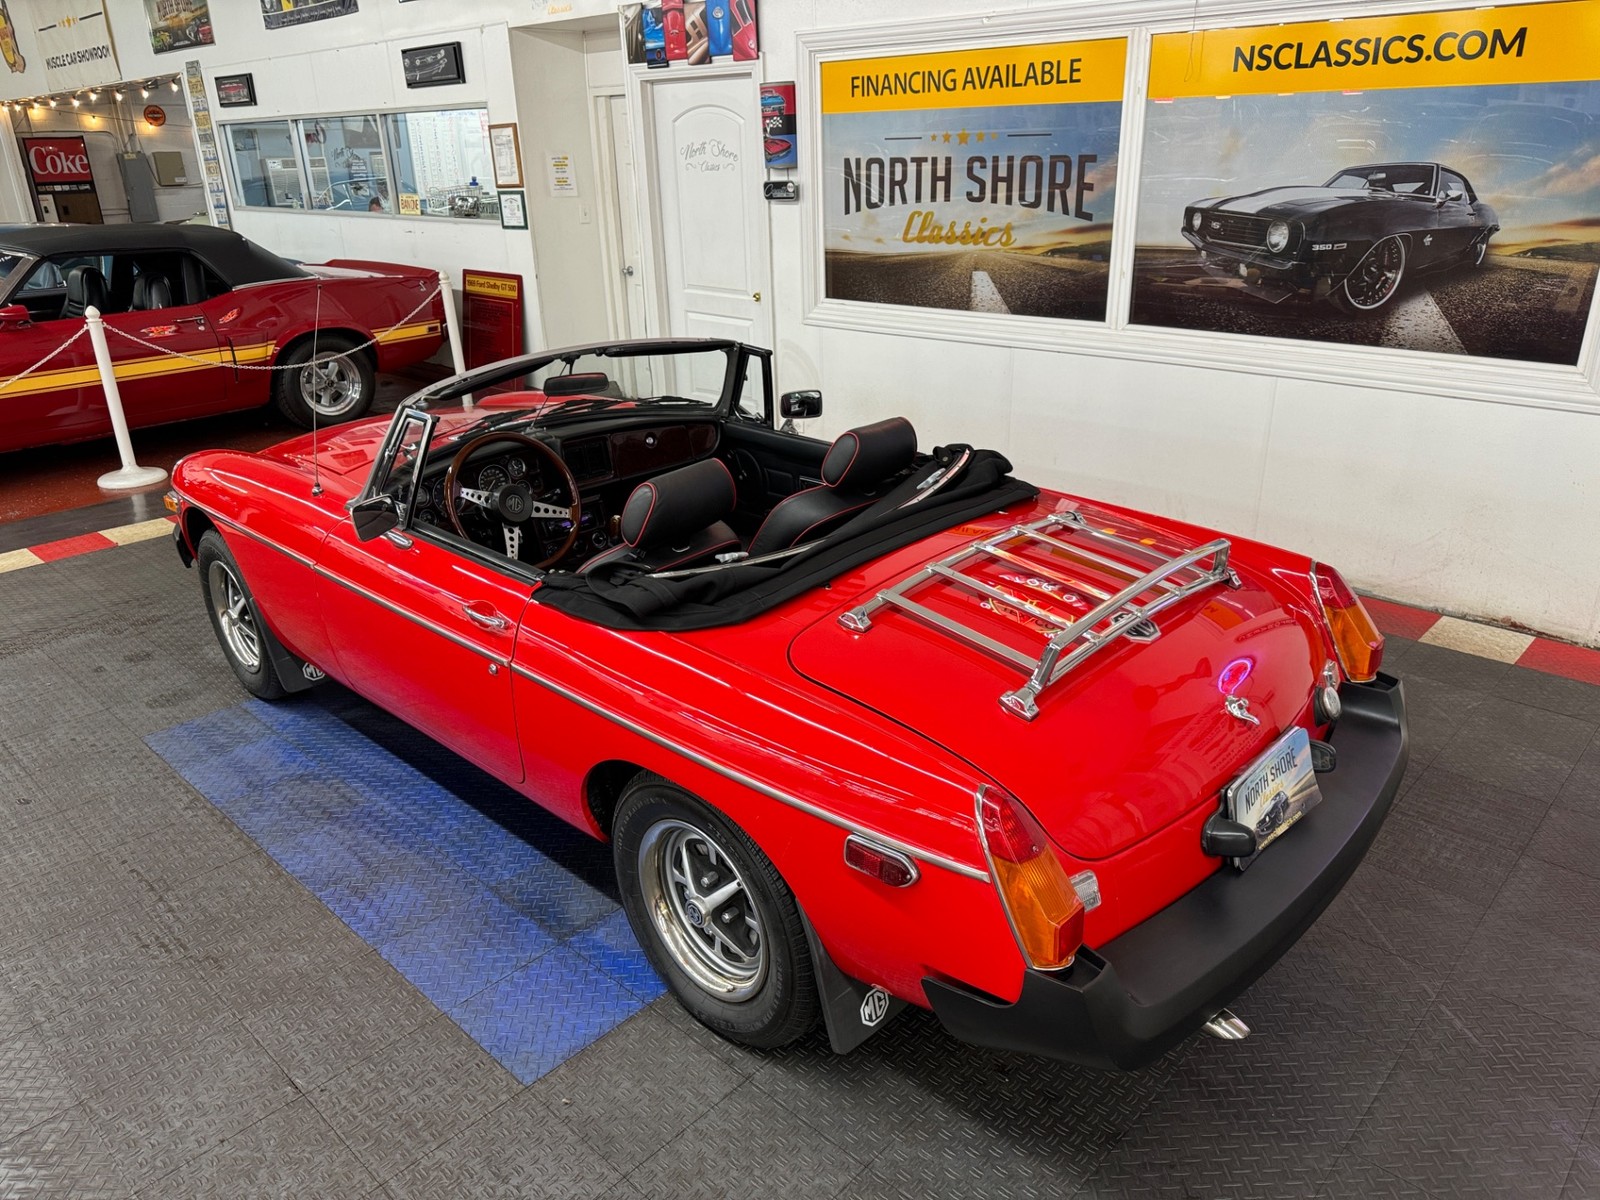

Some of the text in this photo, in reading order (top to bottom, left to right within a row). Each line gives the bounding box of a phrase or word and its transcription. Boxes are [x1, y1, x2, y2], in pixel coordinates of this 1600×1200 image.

[46, 44, 112, 70] MUSCLE CAR SHOWROOM
[1232, 27, 1528, 73] NSCLASSICS.COM
[850, 58, 1082, 98] FINANCING AVAILABLE
[29, 146, 90, 175] Coke
[680, 138, 739, 162] North Shore
[698, 159, 721, 172] Classics
[843, 154, 1098, 222] NORTH SHORE
[901, 210, 1018, 248] Classics
[1311, 243, 1332, 251] 350
[476, 281, 486, 289] Ford
[486, 281, 500, 292] Shelby
[500, 283, 508, 291] GT
[507, 284, 517, 292] 500
[1244, 747, 1298, 815] NORTH SHORE
[863, 990, 886, 1021] MG
